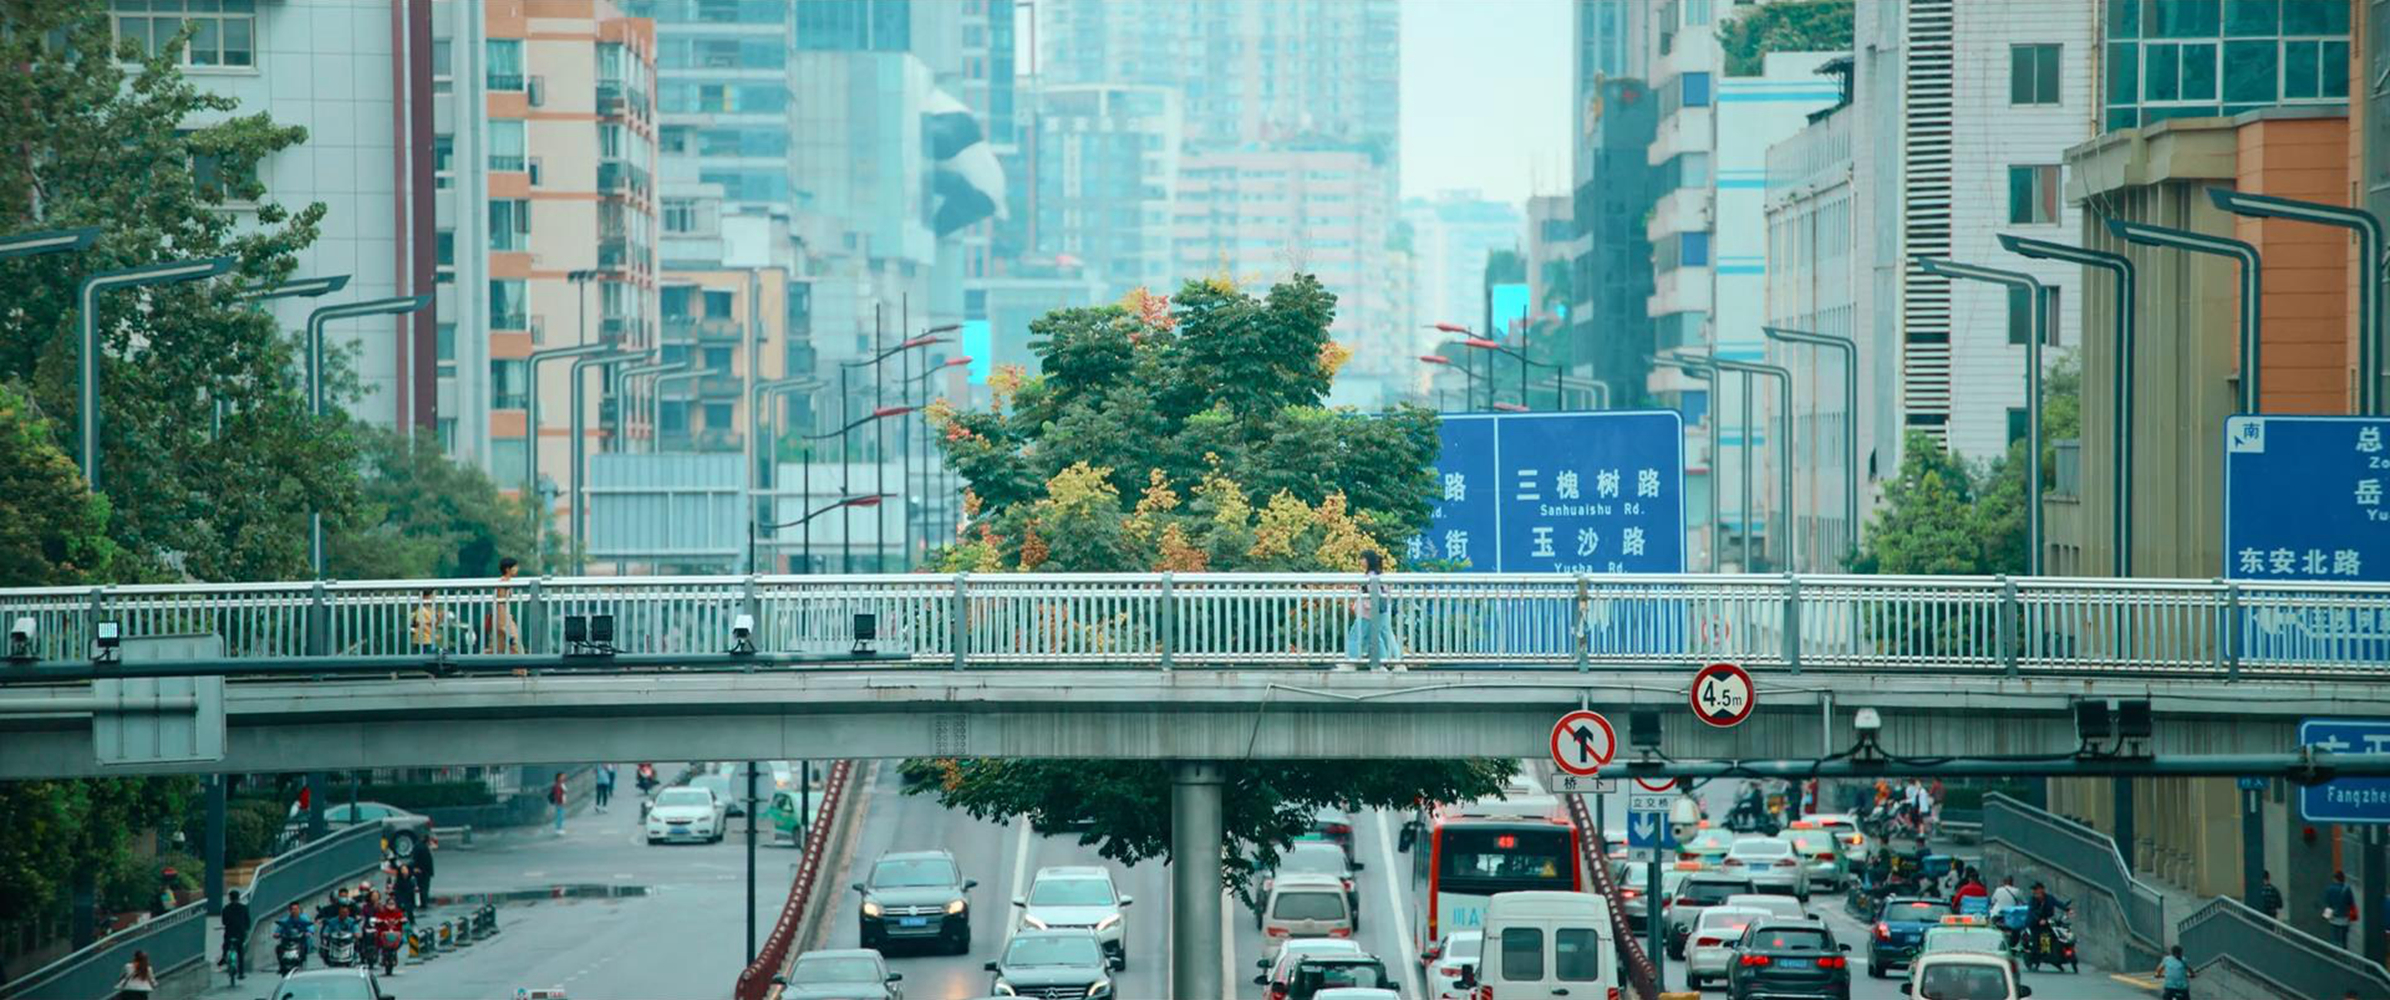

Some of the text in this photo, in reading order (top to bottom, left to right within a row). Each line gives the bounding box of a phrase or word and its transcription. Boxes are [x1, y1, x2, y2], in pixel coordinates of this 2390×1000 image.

[2242, 422, 2260, 439] 南
[2355, 426, 2383, 453] 总
[1516, 467, 1661, 500] 三槐树路
[2354, 479, 2383, 505] 岳
[1540, 502, 1645, 516] Sanhuaishu Rd.
[2366, 509, 2390, 521] Yu
[1531, 526, 1645, 557] 玉沙路
[1554, 562, 1594, 573] Yusha
[2238, 547, 2361, 576] 东安北路
[1702, 681, 1742, 707] 4.5m
[1563, 776, 1604, 790] 桥下
[2327, 785, 2390, 808] Fangzhe
